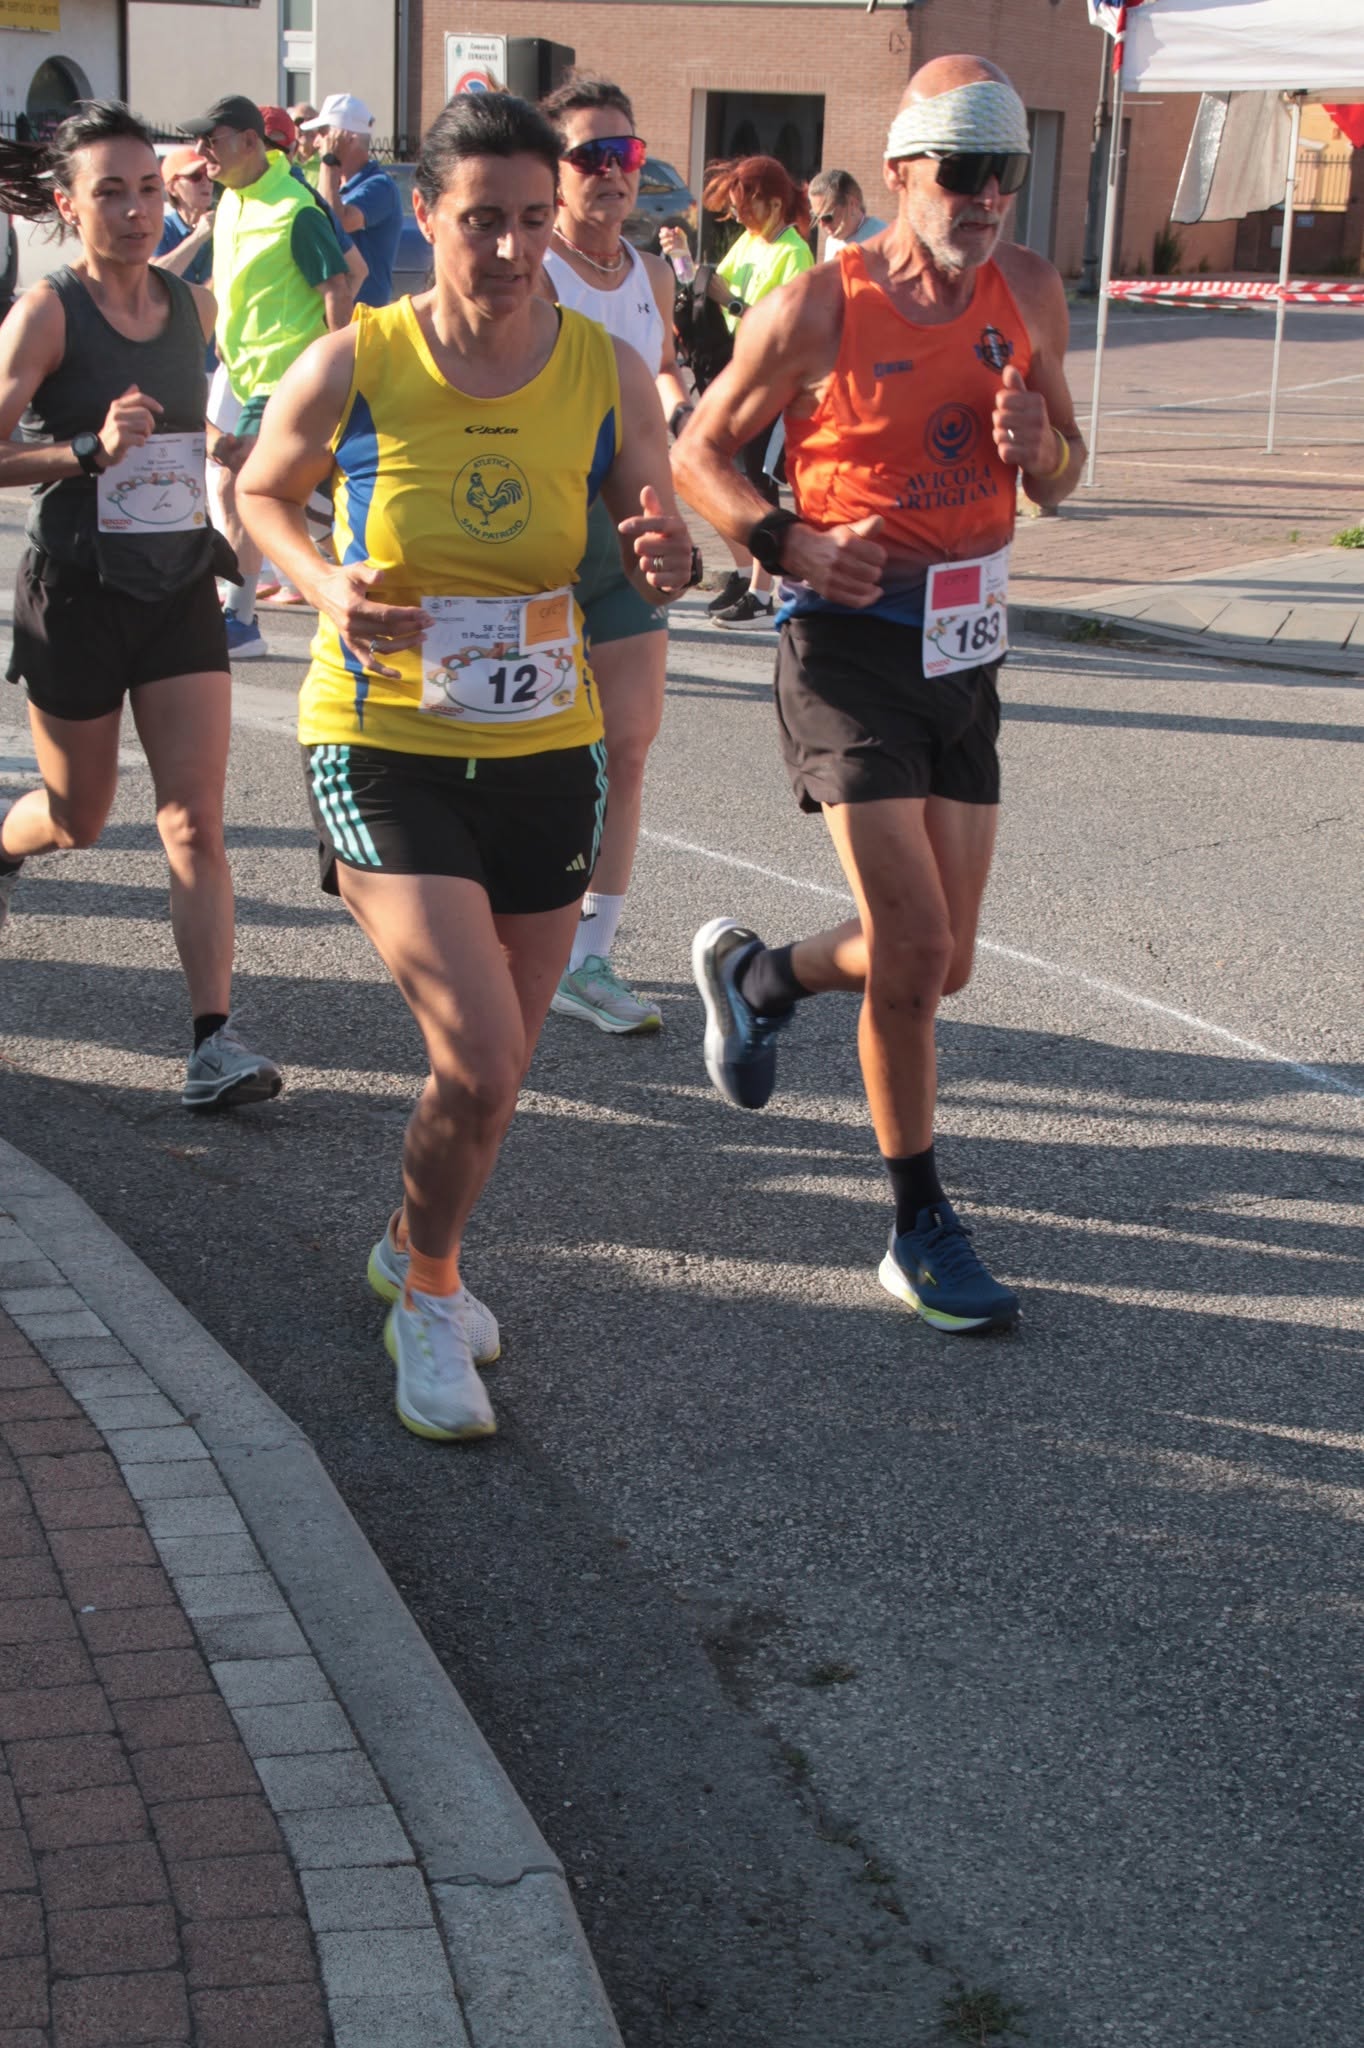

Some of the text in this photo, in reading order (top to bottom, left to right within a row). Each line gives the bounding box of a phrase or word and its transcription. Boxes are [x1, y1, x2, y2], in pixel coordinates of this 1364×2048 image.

[473, 457, 511, 470] ATLETICA
[460, 518, 524, 540] SAN PATRIZIO
[955, 611, 999, 654] 183
[488, 664, 538, 705] 12
